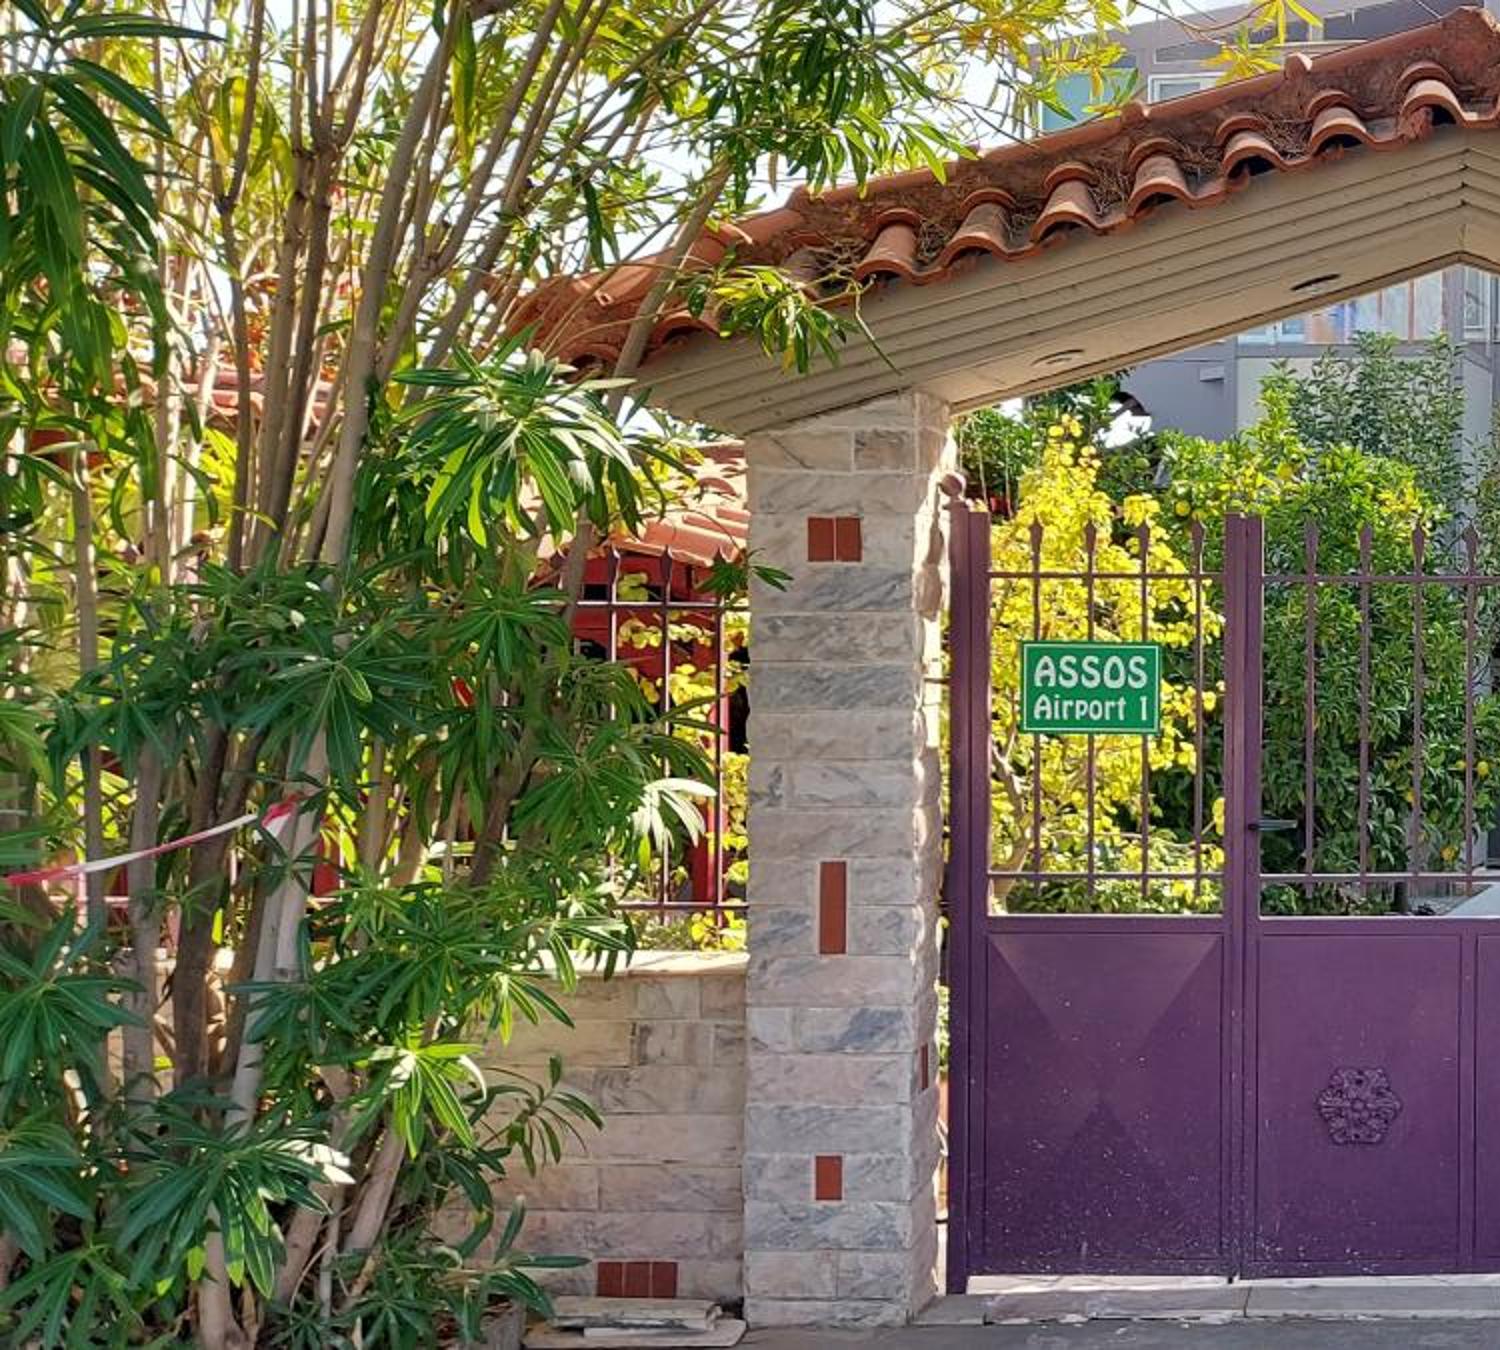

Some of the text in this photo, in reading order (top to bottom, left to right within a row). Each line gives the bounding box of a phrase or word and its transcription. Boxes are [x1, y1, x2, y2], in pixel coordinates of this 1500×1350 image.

[1034, 655, 1148, 689] ASSOS
[1033, 693, 1148, 721] Airport 1
